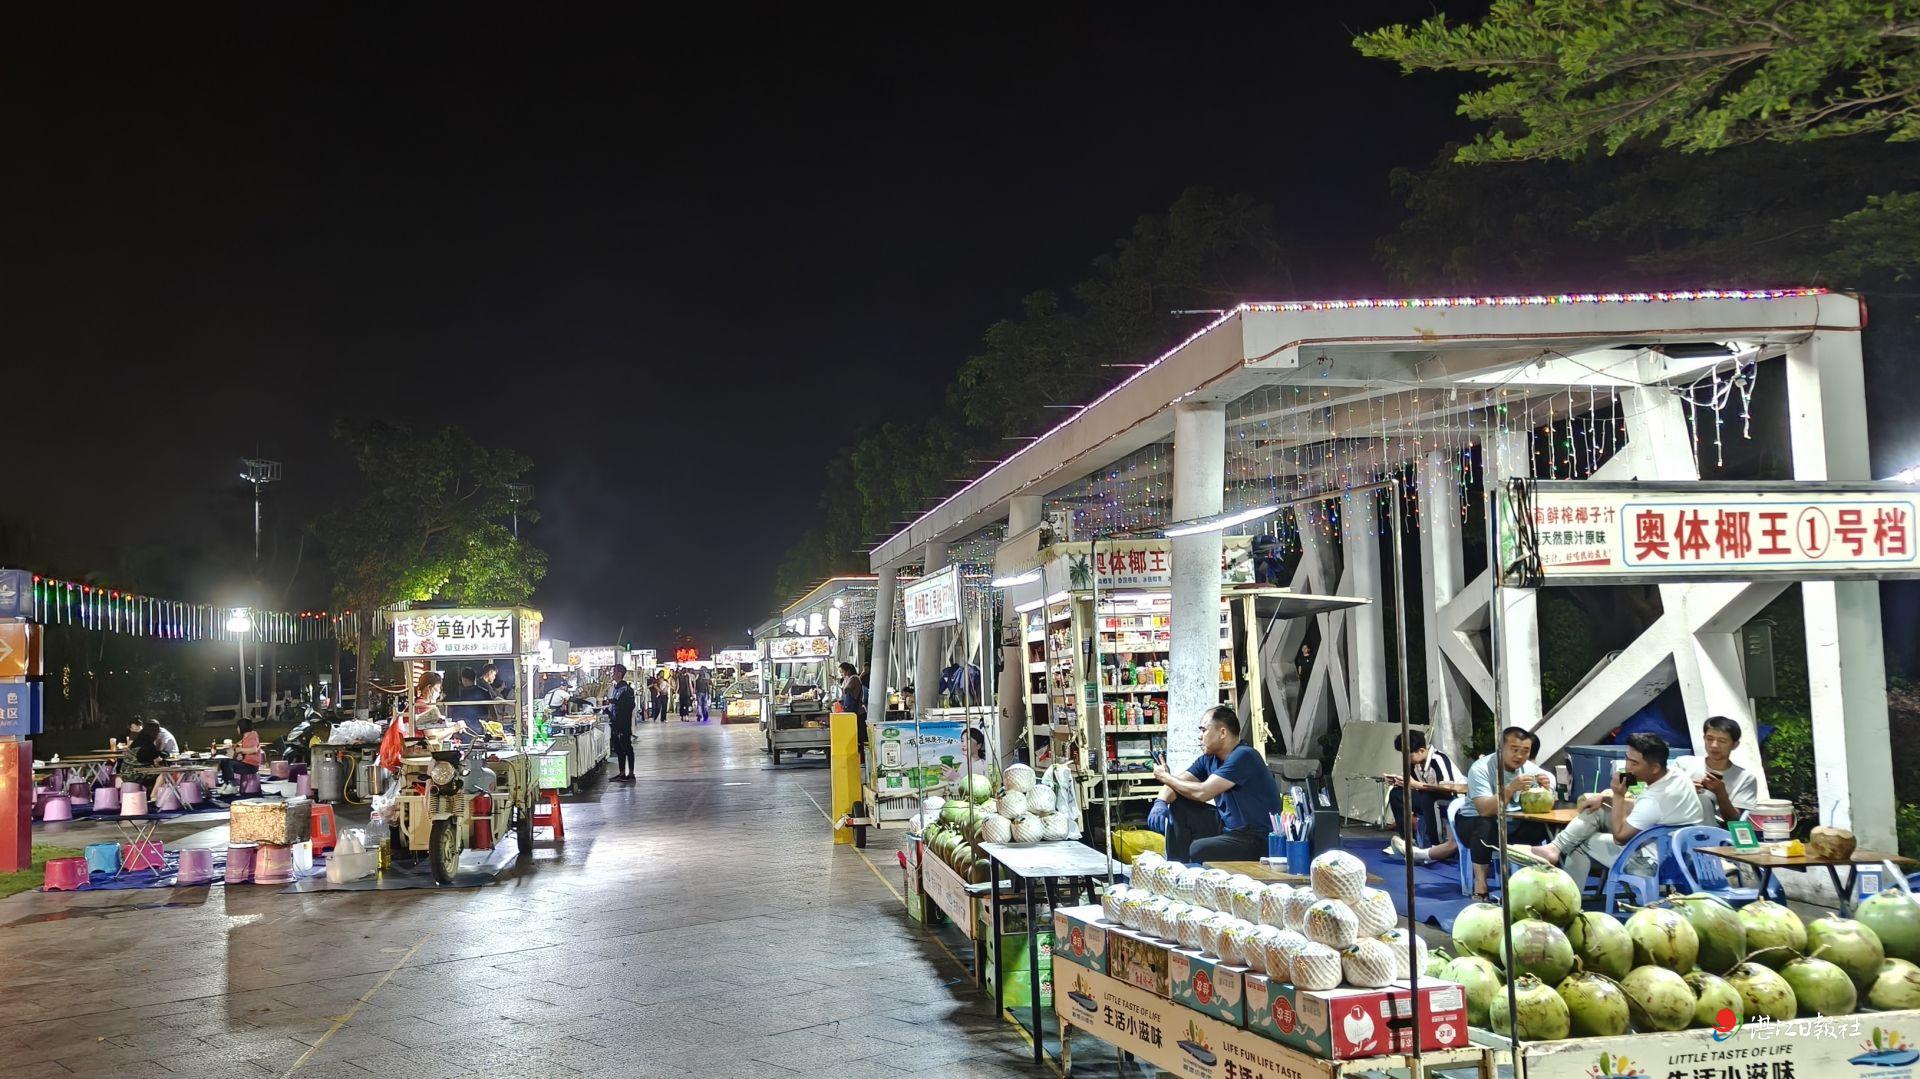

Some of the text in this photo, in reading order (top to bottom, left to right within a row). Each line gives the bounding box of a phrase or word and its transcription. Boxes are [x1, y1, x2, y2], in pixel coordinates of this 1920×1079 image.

[436, 619, 510, 639] 章鱼小丸子
[1104, 992, 1161, 1023] LITTLE TASTE OF LIFE
[1104, 1005, 1163, 1048] 生活小滋味
[1223, 1041, 1301, 1079] LIFE FUN LIFE TASTE
[1668, 1044, 1793, 1065] LITTLE TASTE OF LIFE
